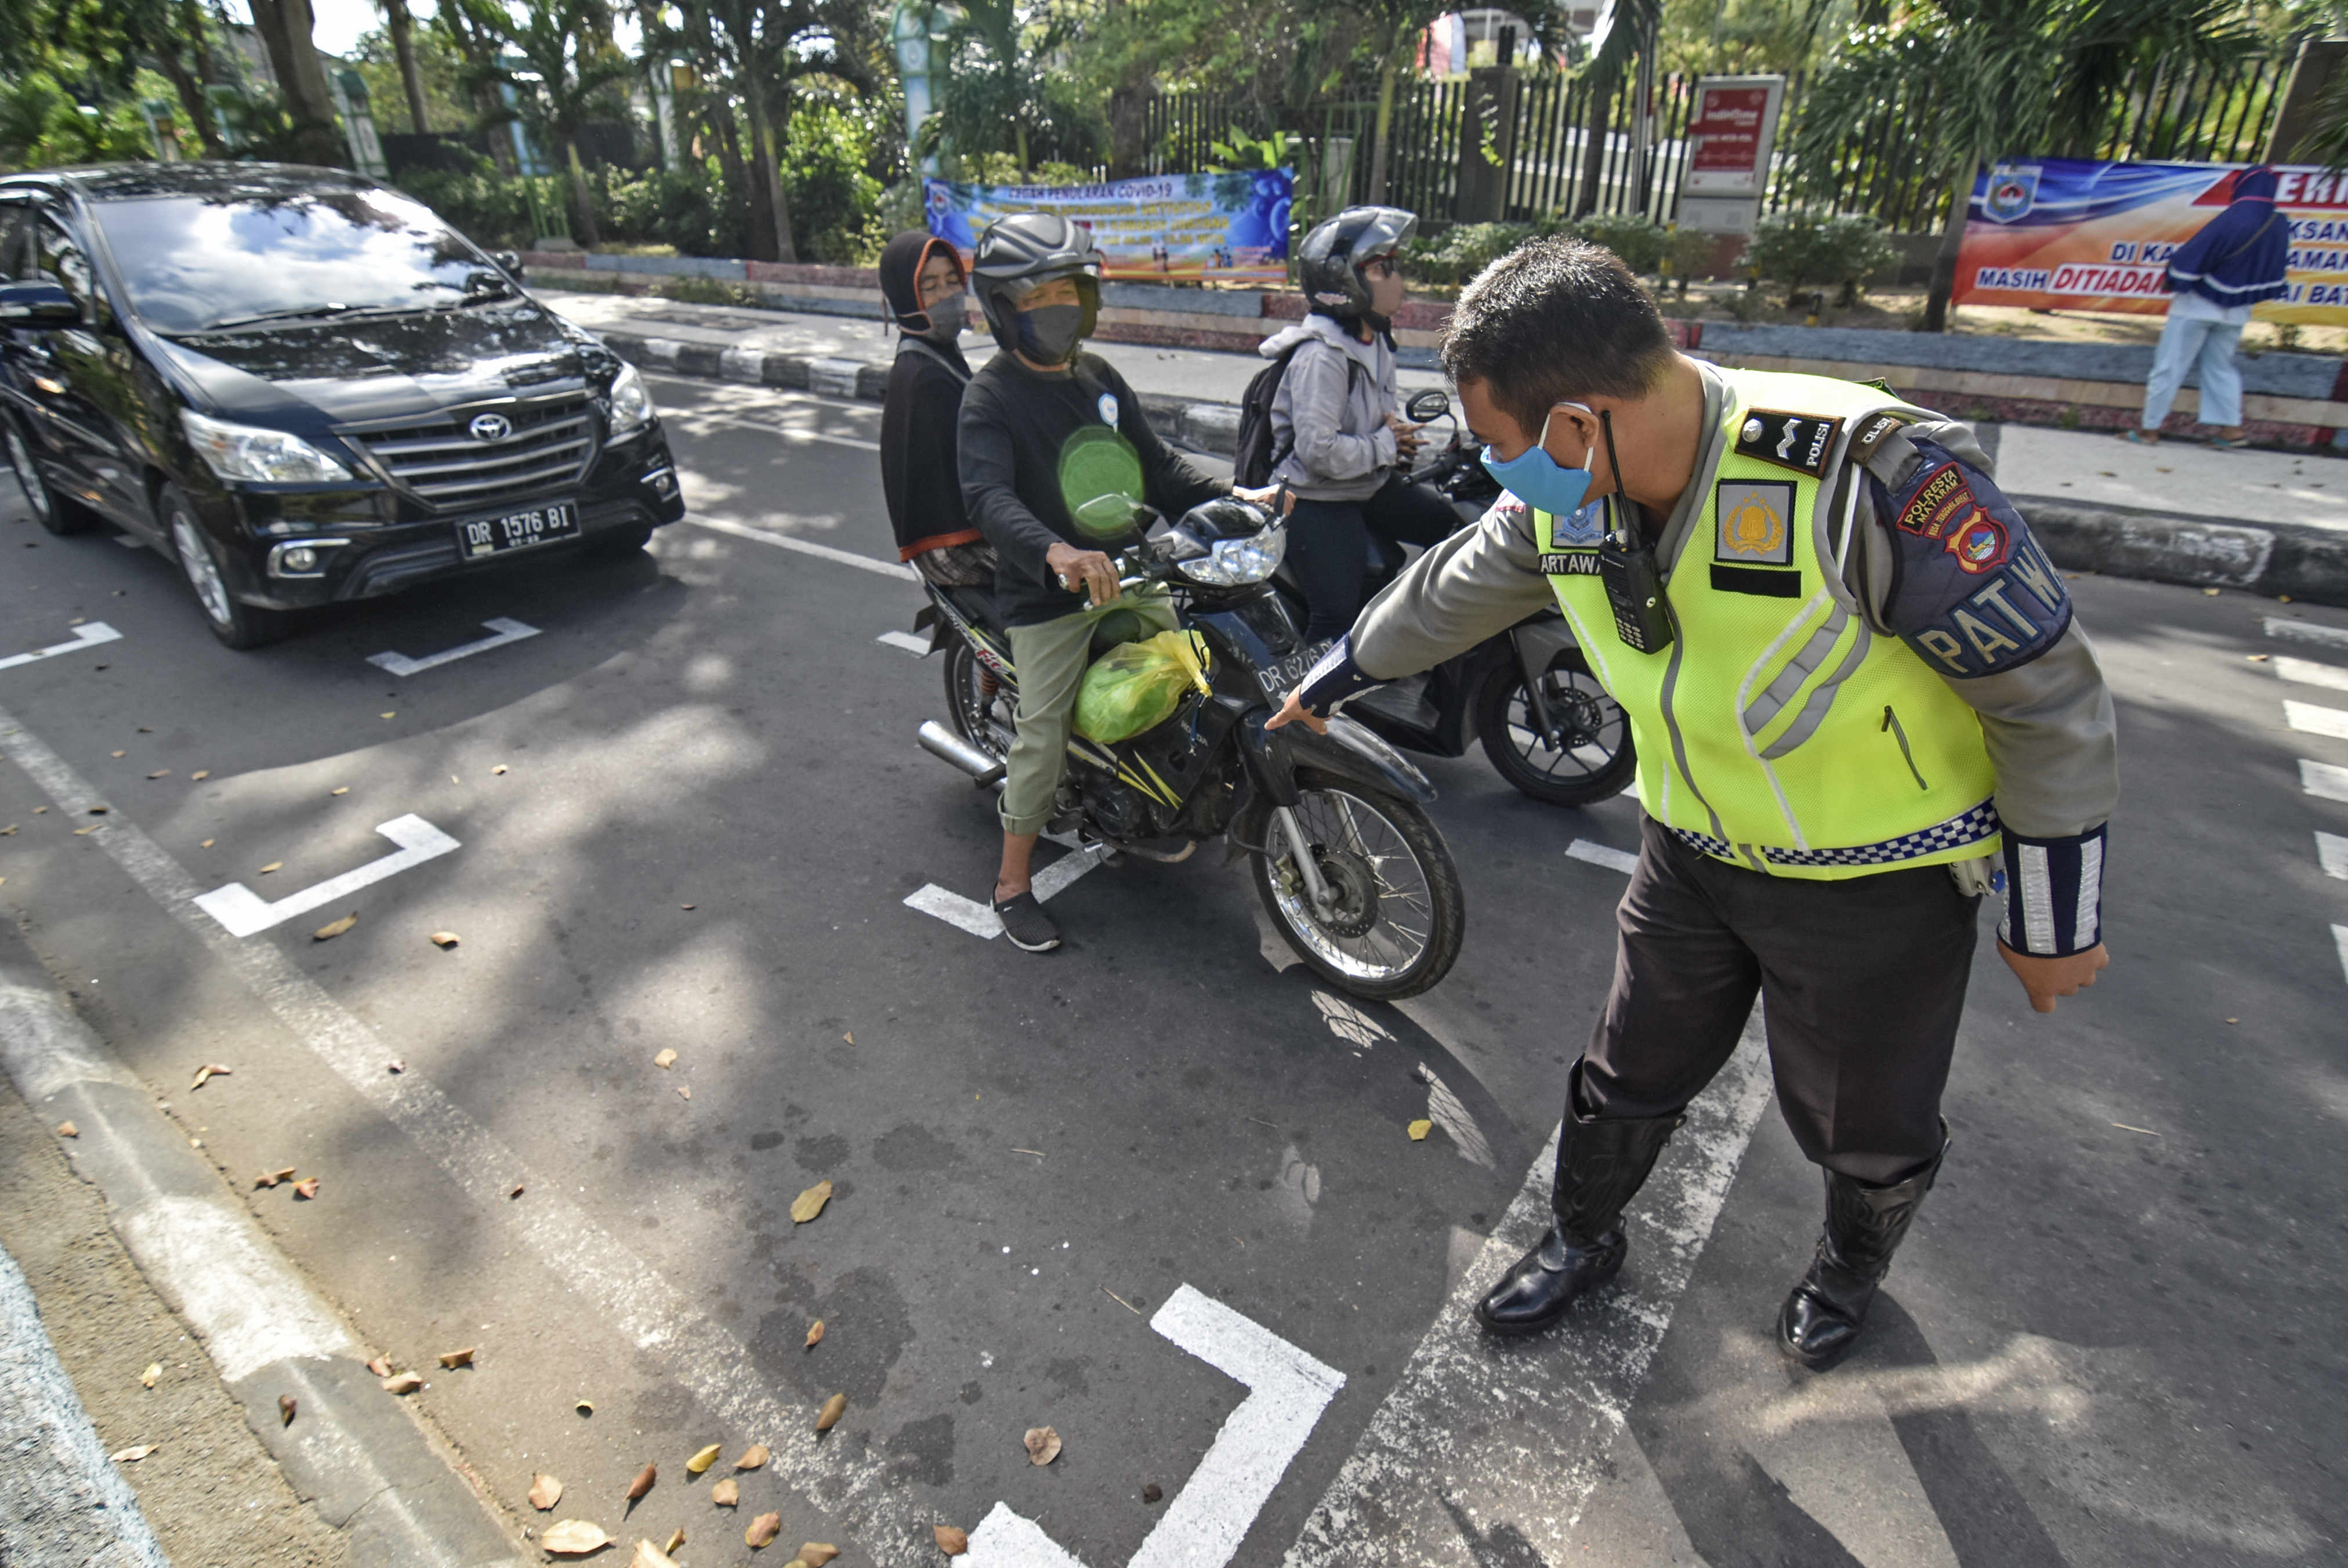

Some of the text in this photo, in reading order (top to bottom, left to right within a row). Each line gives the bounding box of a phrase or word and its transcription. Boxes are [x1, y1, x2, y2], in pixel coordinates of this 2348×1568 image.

[1118, 182, 1172, 198] COVID-19
[2111, 244, 2136, 260] DI
[2143, 244, 2173, 262] KA
[1978, 270, 2049, 288] MASIH
[1806, 423, 1831, 467] POLISI
[1904, 469, 1958, 524] POLRESTA
[1916, 479, 1959, 523] MATARAM
[467, 522, 493, 545] DR
[501, 511, 545, 538] 1576
[1259, 665, 1287, 692] DR
[1181, 720, 1208, 747] HODA
